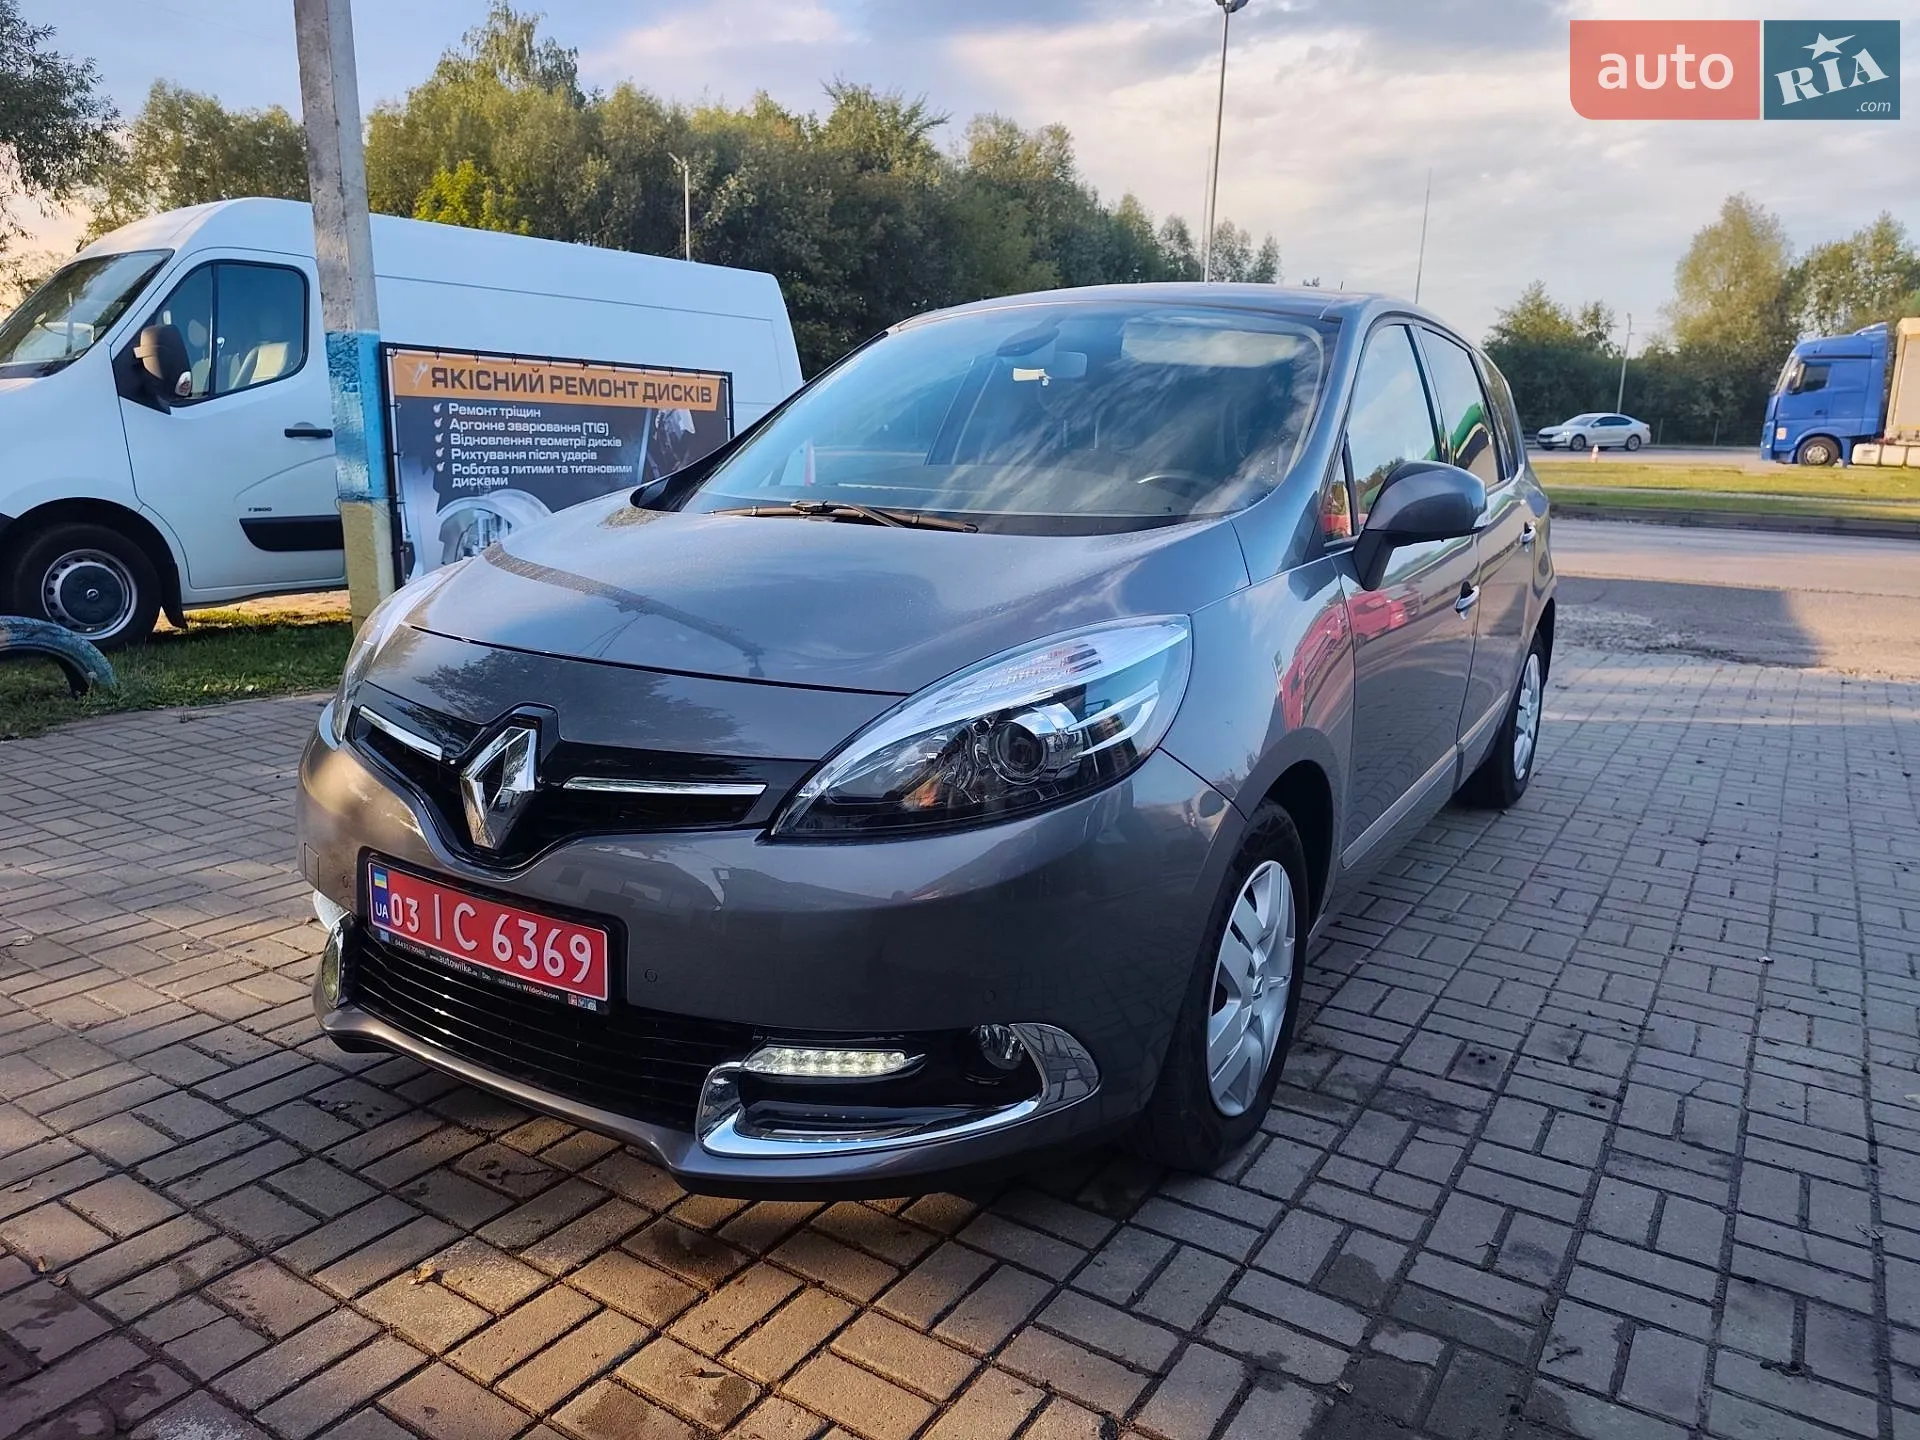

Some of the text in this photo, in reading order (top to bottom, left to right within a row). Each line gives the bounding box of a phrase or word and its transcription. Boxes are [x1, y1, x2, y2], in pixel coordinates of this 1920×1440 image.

[431, 367, 712, 404] ЯКІСНИЙ РЕМОНТ ДИСКІВ
[448, 403, 541, 419] Ремонт тріщин
[449, 418, 505, 433] Аргонне
[507, 421, 581, 434] зварювання
[450, 433, 622, 449] Відновлення геометрії дисків
[451, 448, 597, 463] Рихтування після ударів
[451, 463, 632, 475] Робота з литими та титановими
[452, 477, 508, 488] дисками
[375, 902, 389, 919] UA
[391, 893, 419, 933] 03
[492, 914, 592, 983] 6369
